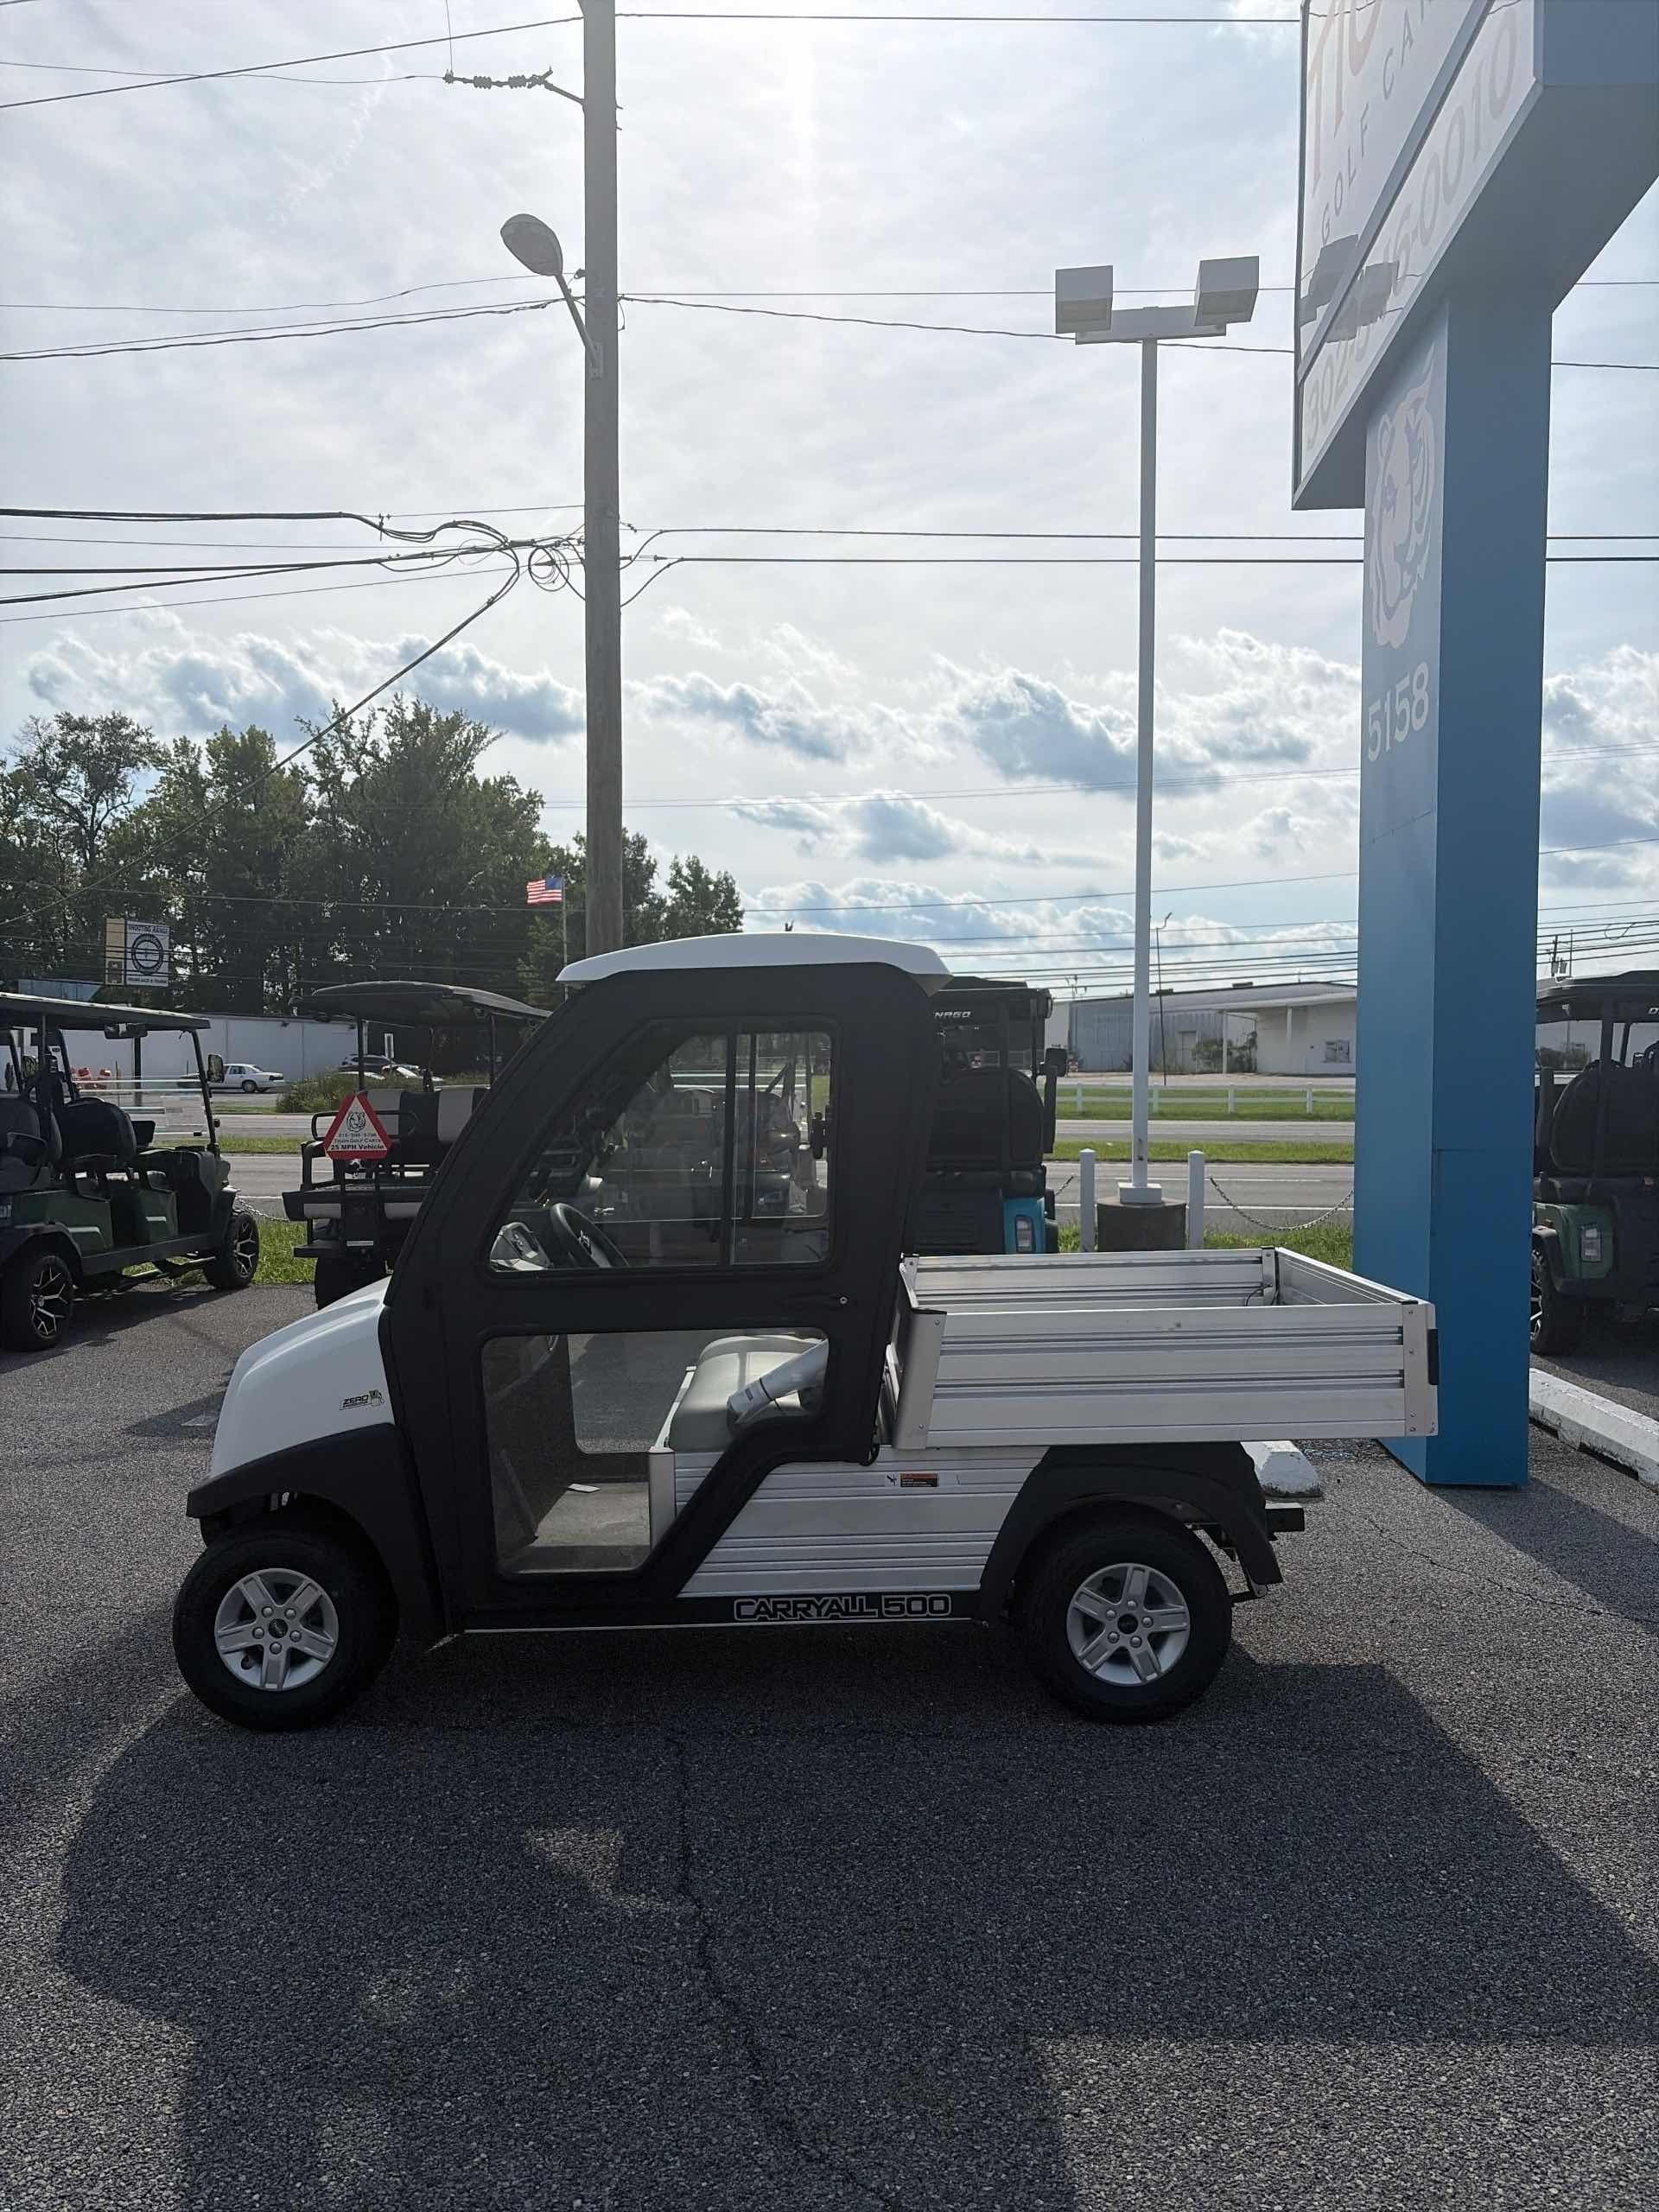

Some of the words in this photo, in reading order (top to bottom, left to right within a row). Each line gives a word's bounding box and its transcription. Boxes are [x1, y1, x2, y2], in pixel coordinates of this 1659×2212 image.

[1321, 102, 1370, 249] GOLF
[1367, 660, 1430, 763] 5158
[734, 1596, 879, 1621] CARRYALL
[881, 1593, 951, 1618] 500
